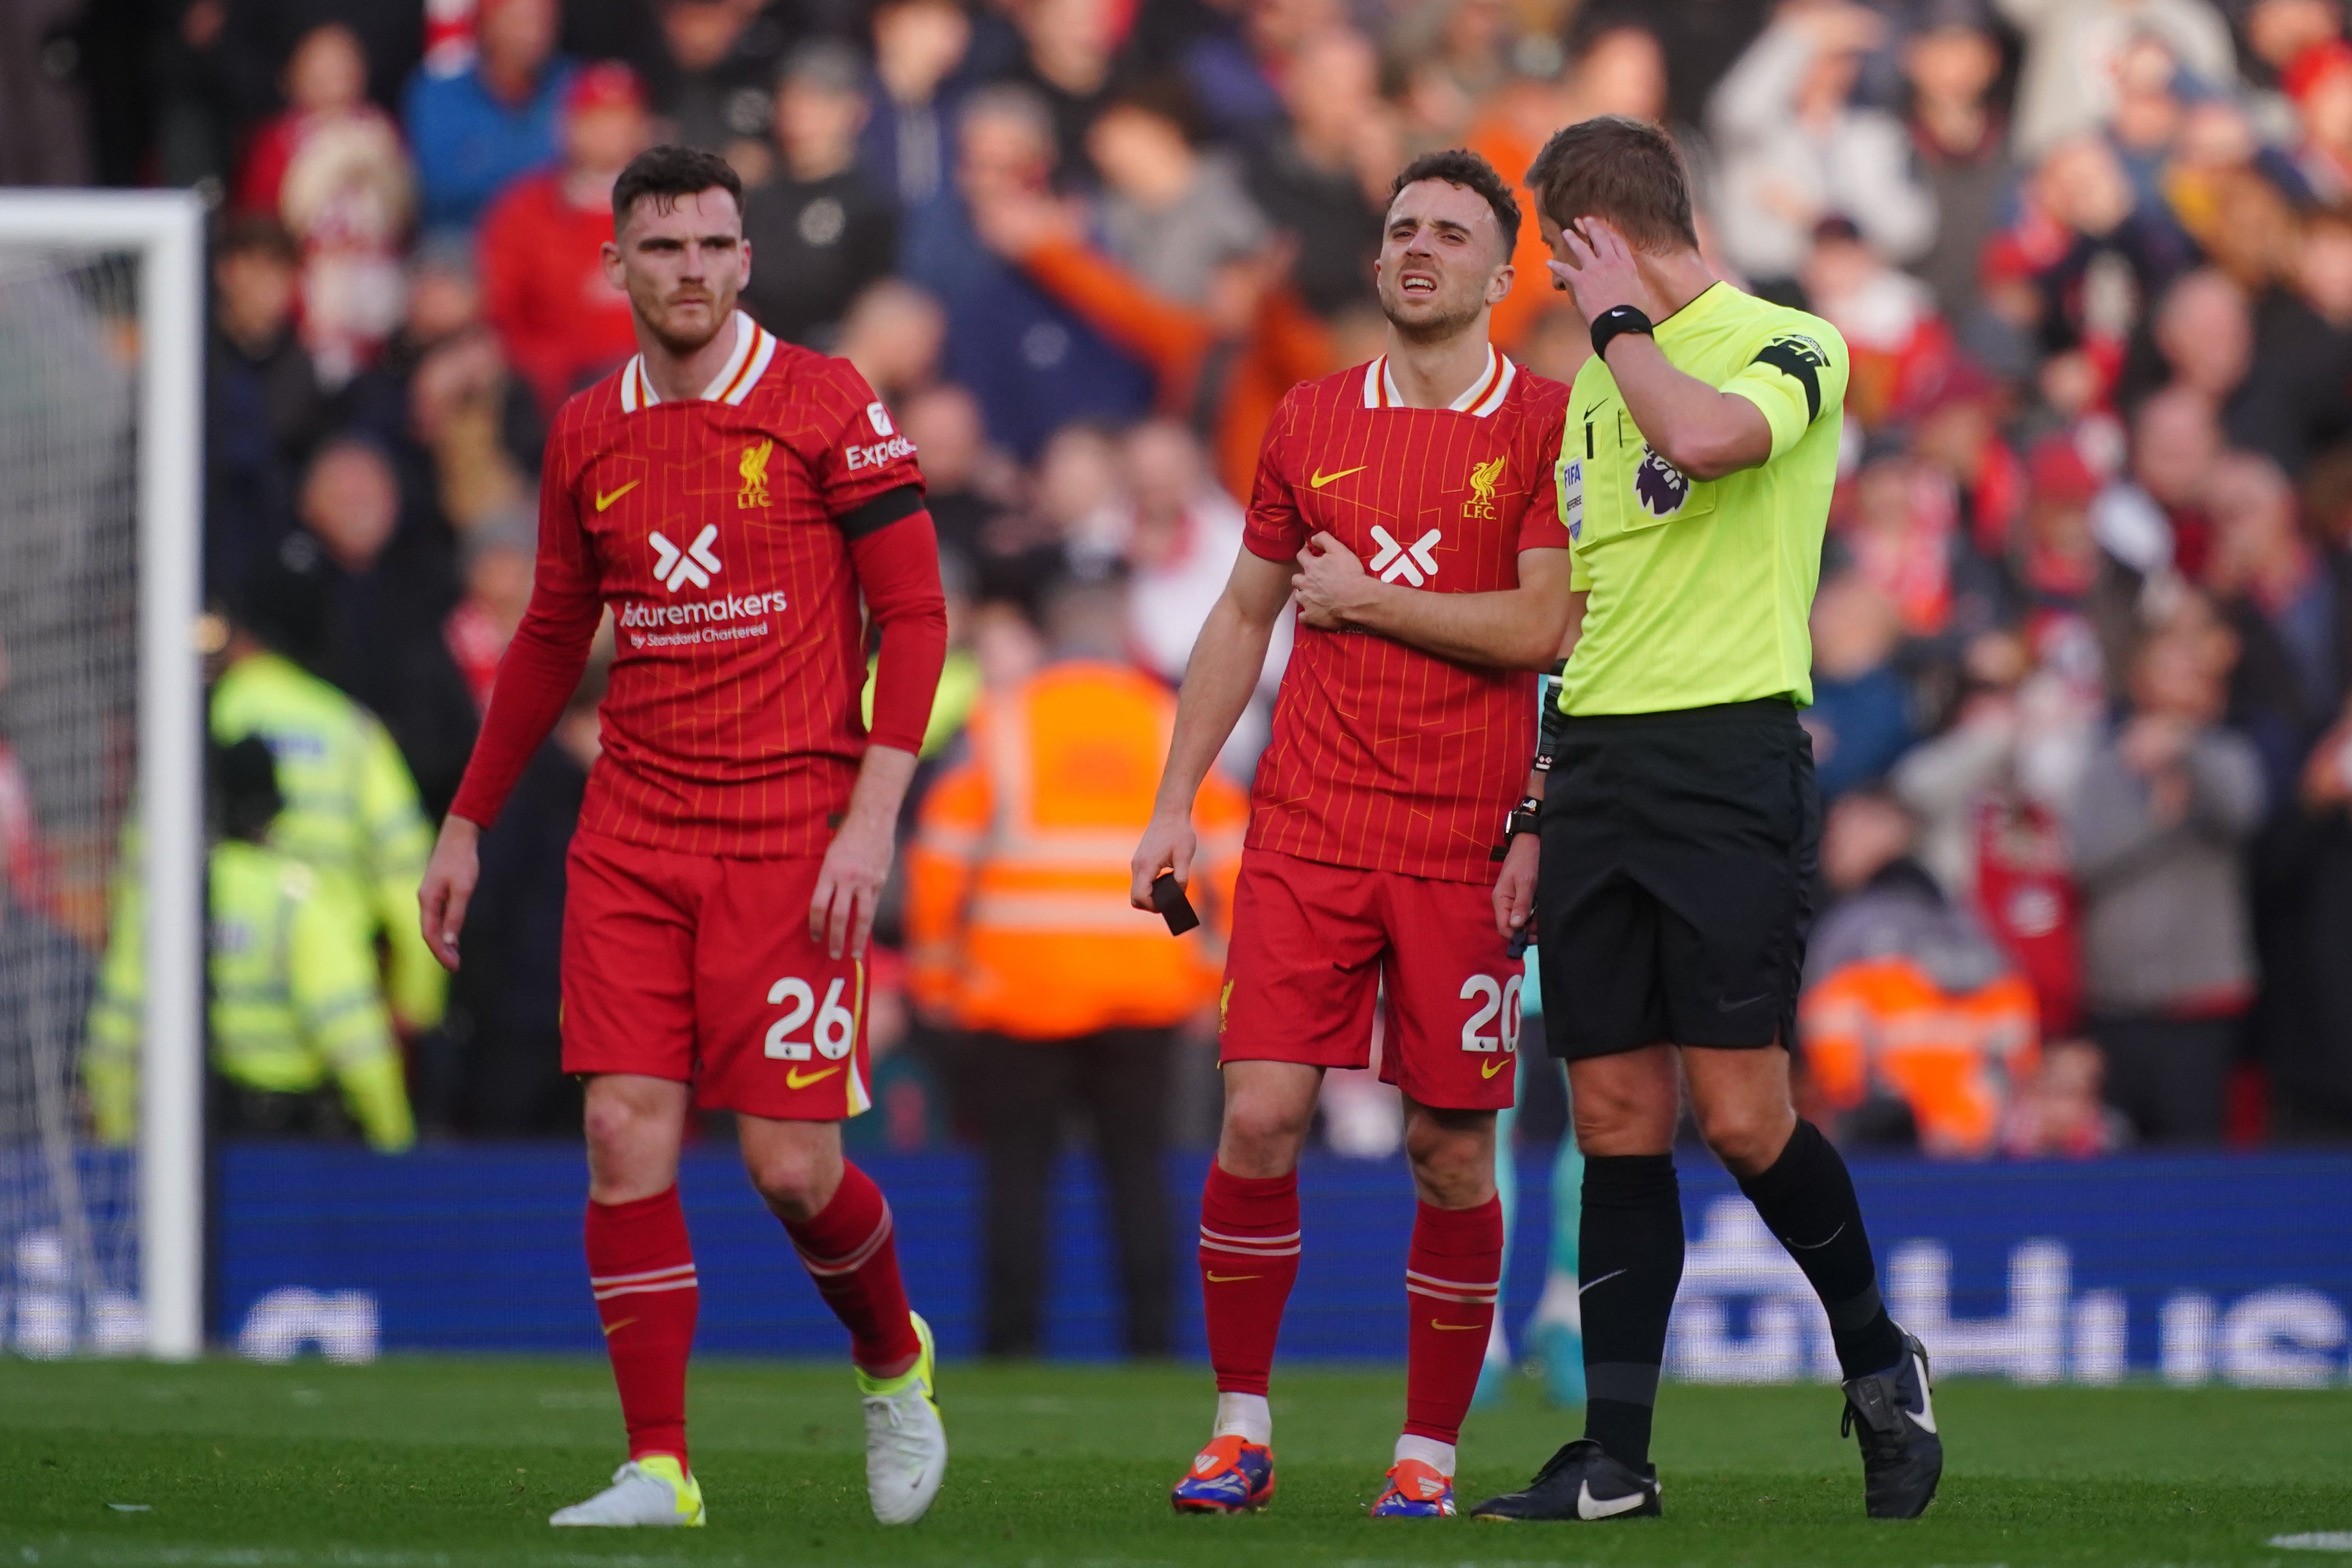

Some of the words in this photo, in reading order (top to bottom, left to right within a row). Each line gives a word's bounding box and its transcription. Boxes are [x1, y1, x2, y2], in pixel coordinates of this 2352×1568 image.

[1564, 463, 1581, 489] FIFA
[630, 633, 647, 650] by
[647, 628, 701, 647] Standard
[702, 620, 768, 643] Chartered
[764, 976, 853, 1061] 26
[1459, 973, 1522, 1052] 20
